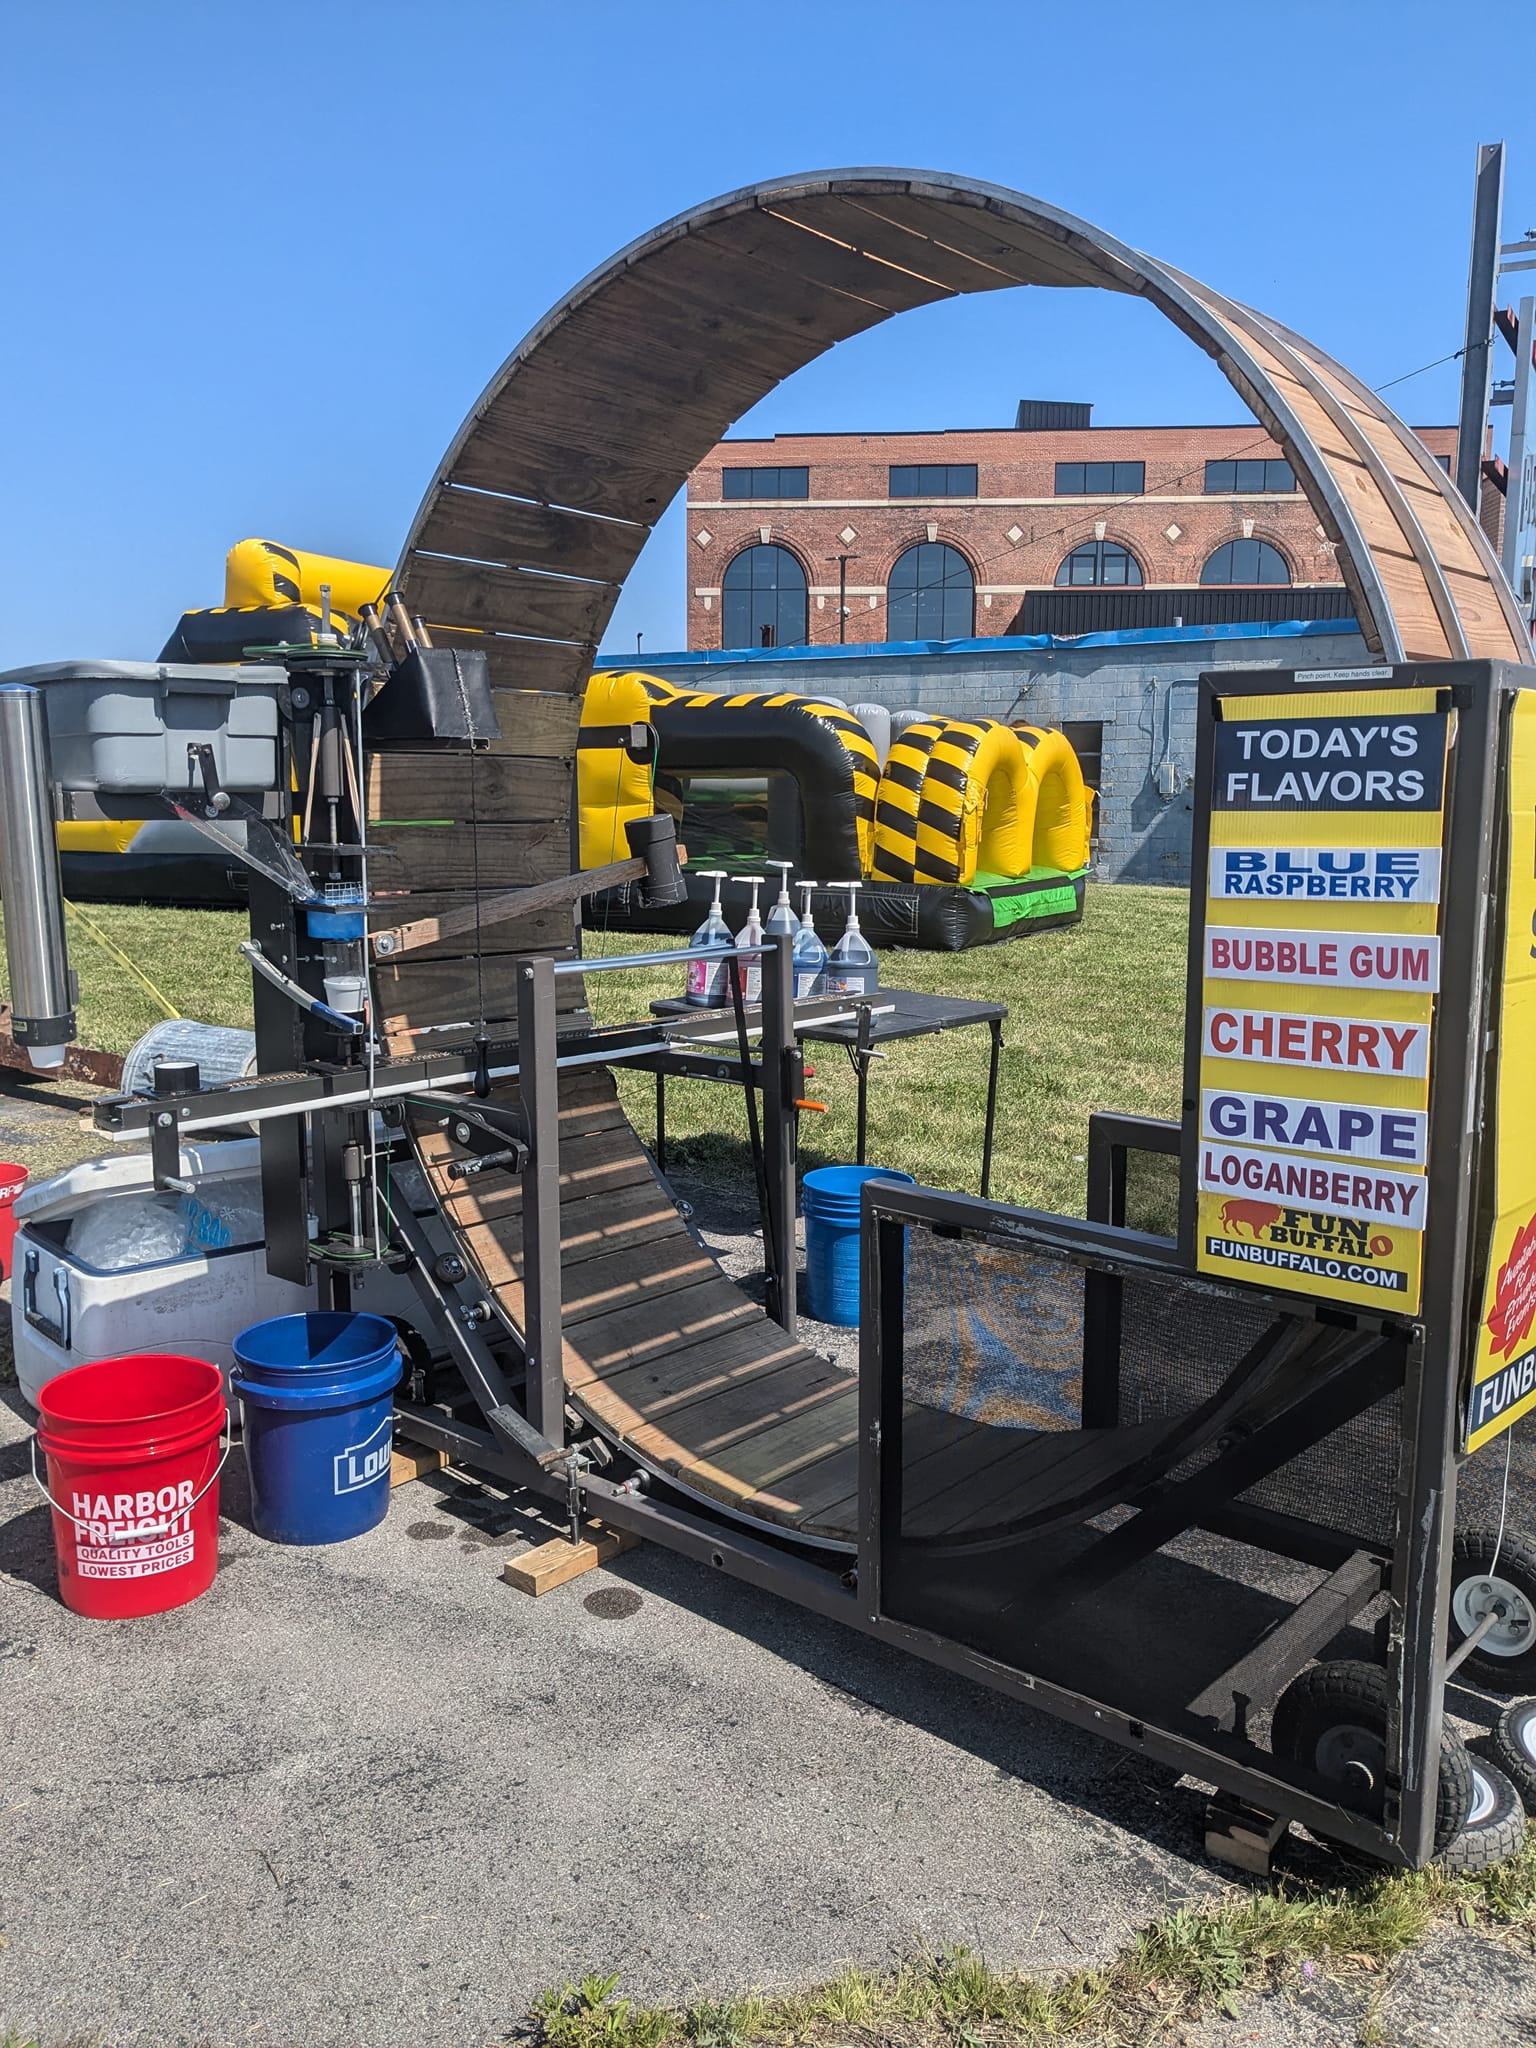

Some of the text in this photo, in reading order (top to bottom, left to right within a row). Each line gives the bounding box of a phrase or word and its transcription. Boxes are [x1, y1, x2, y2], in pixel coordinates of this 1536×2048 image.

[1297, 672, 1314, 680] Pinch
[1315, 671, 1332, 680] point.
[1333, 670, 1350, 679] Keep
[1351, 669, 1370, 678] hands
[1236, 725, 1419, 760] TODAY'S
[1226, 770, 1425, 802] FLAVORS
[1225, 852, 1420, 875] BLUE
[1224, 873, 1418, 898] RASPBERRY
[1211, 937, 1430, 982] BUBBLE GUM
[1210, 1012, 1419, 1071] CHERRY
[1209, 1096, 1418, 1160] GRAPE
[1205, 1151, 1419, 1217] LOGANBERRY
[1282, 1207, 1371, 1241] FUN
[1270, 1225, 1394, 1260] BUFFALO
[1210, 1239, 1398, 1289] FUNBUFFALO.COM
[1478, 1353, 1536, 1425] FUNB
[72, 1480, 194, 1520] HARBOR
[81, 1534, 191, 1560] QUALITY TOOLS
[82, 1551, 190, 1577] LOWEST PRICES
